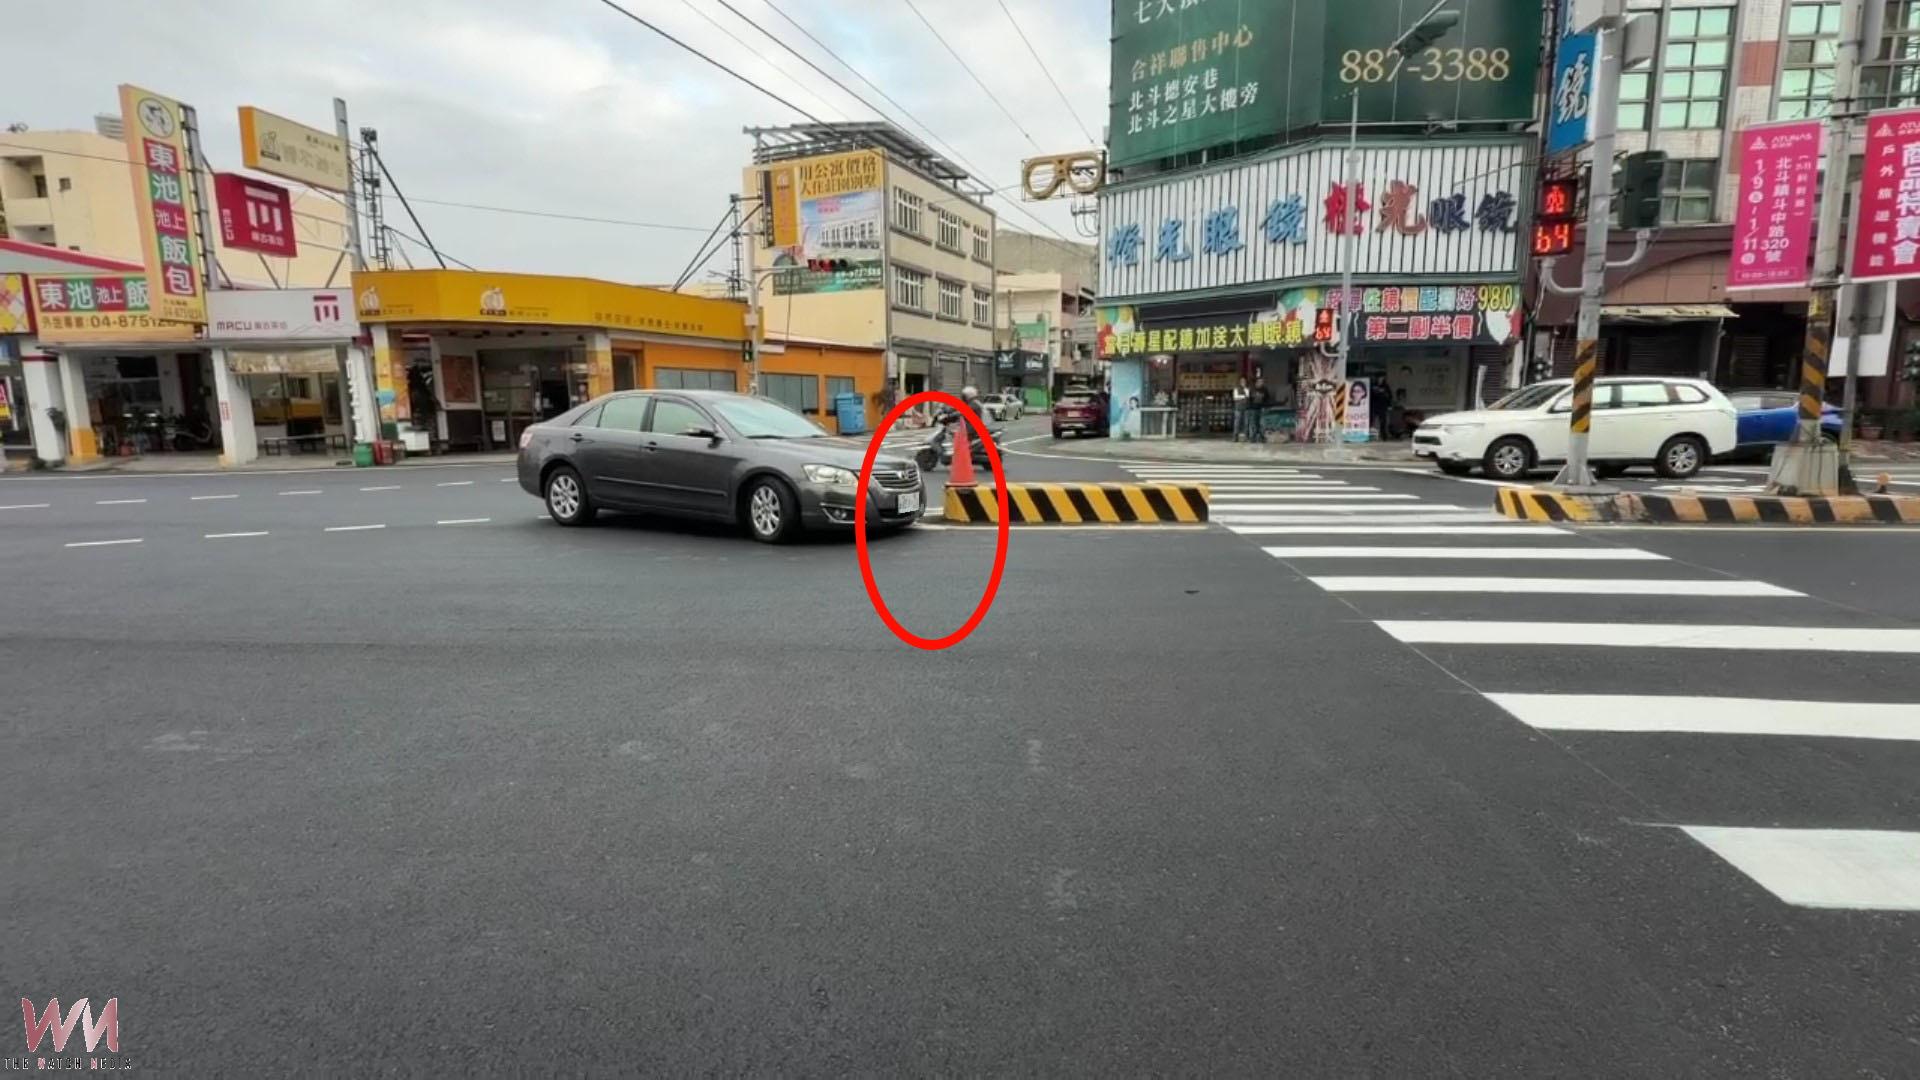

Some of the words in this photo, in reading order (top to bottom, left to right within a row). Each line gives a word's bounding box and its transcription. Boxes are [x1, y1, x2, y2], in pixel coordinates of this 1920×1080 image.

[1339, 48, 1510, 83] 887-3388
[147, 142, 194, 296] 東池池上飯包
[1535, 223, 1569, 253] 64
[1478, 284, 1514, 312] 980
